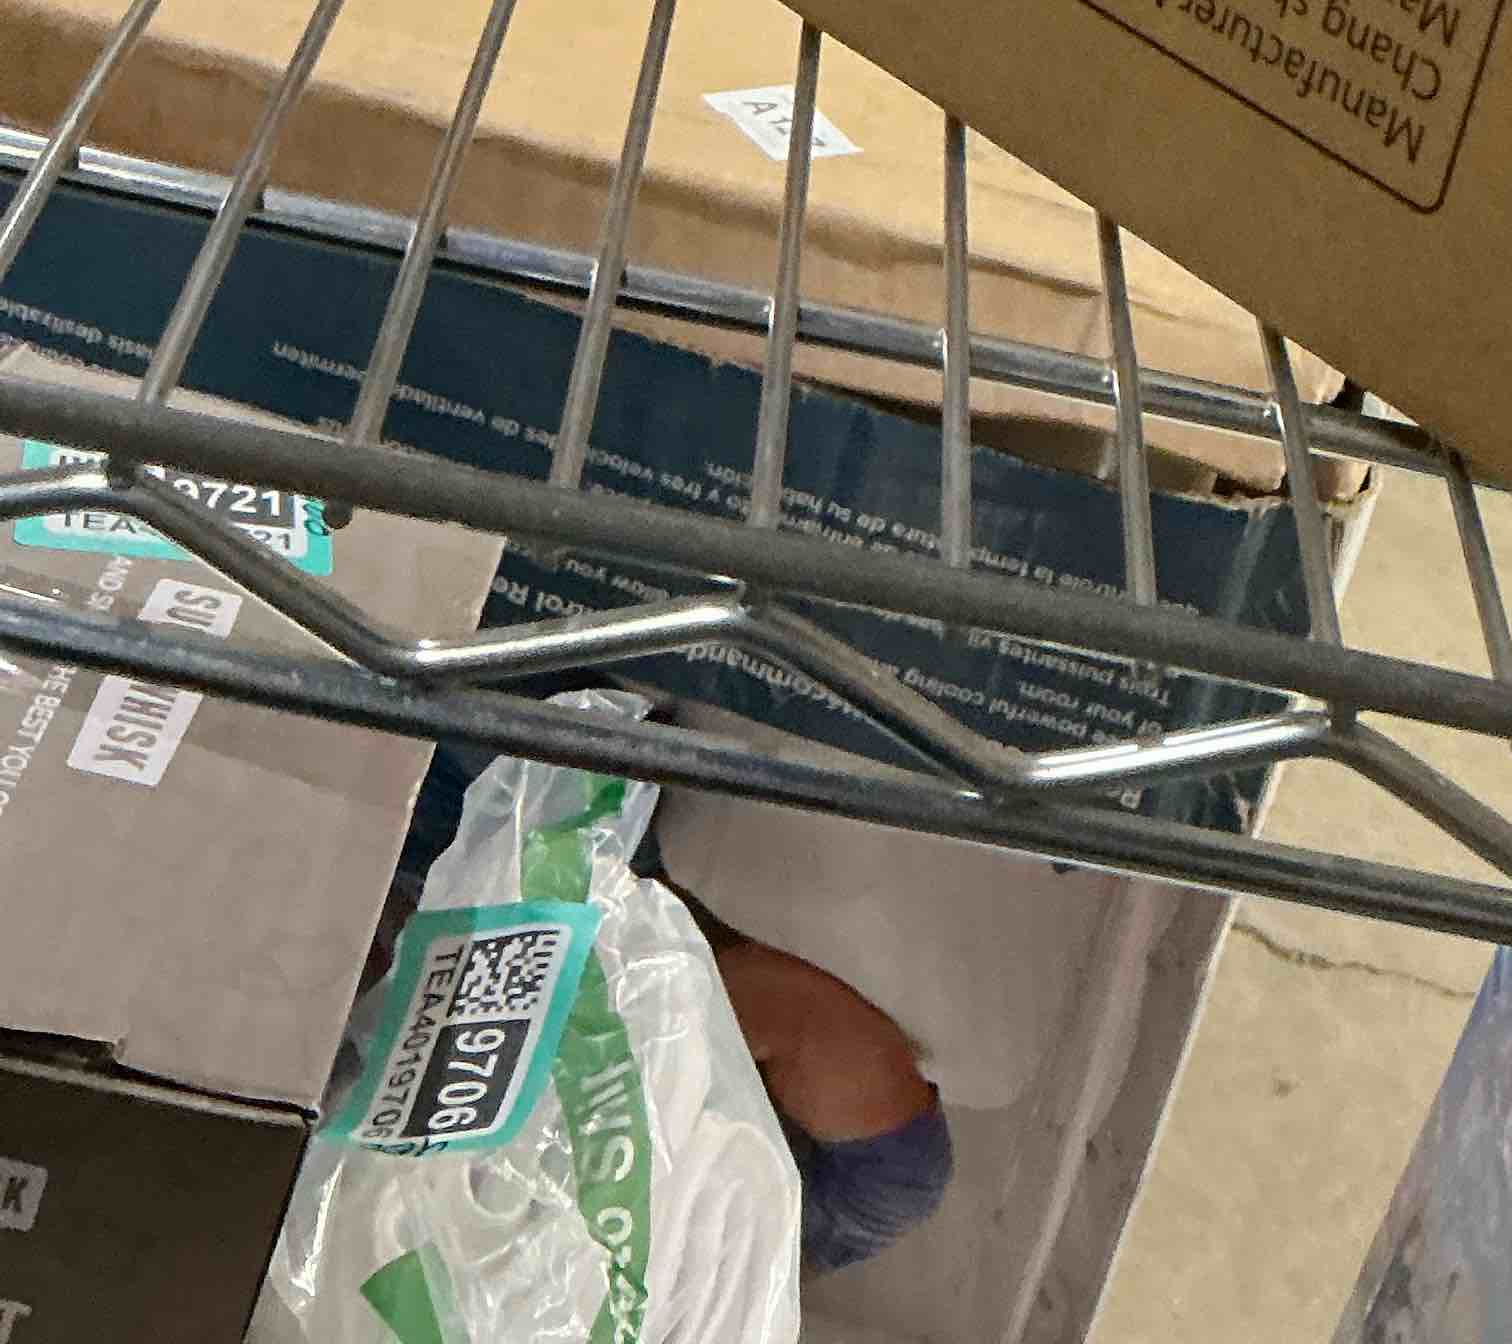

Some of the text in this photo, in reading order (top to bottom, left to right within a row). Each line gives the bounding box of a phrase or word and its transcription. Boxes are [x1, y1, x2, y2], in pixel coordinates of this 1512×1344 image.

[172, 477, 282, 517] 9721
[18, 694, 60, 744] BEST
[428, 1026, 507, 1133] 9706
